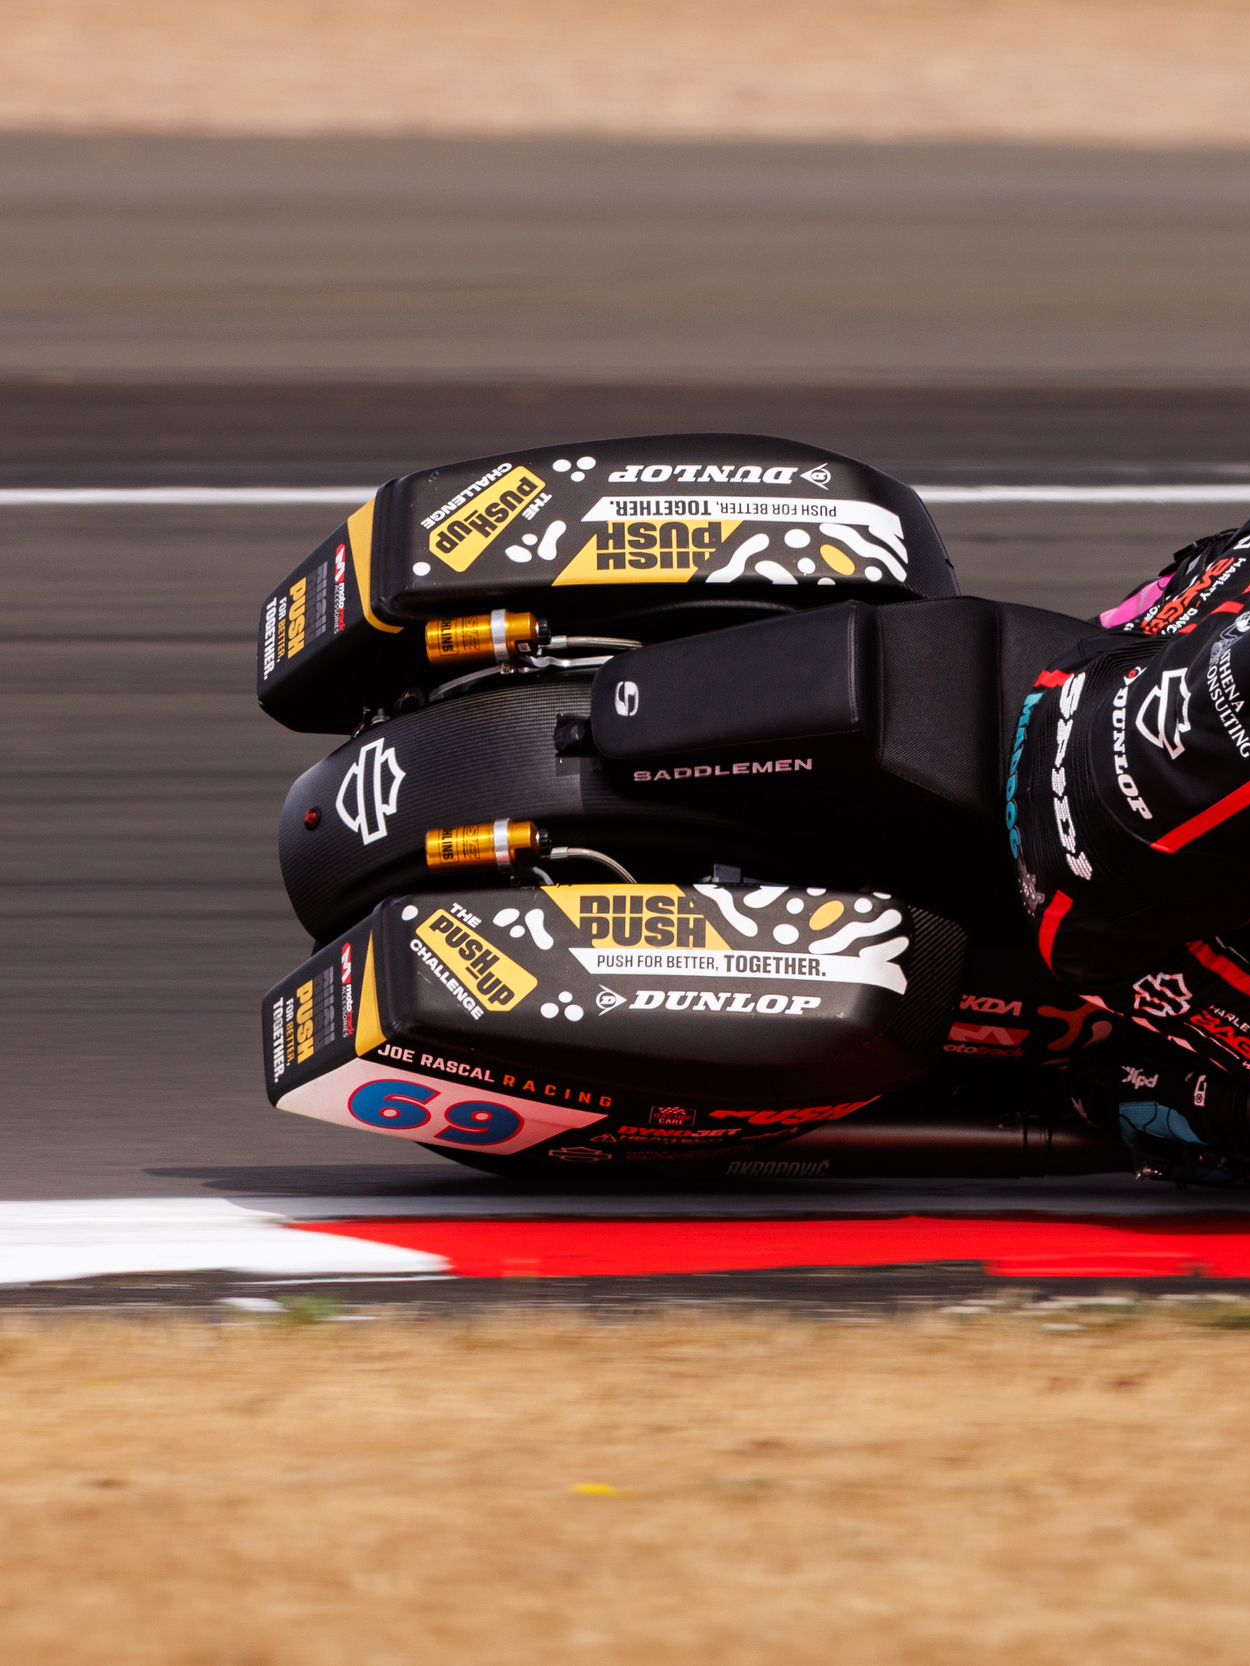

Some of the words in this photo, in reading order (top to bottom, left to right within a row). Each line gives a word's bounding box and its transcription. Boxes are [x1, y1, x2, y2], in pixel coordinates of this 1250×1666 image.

[608, 464, 798, 484] DUNLOP
[420, 462, 513, 530] CHALLENGE
[522, 492, 552, 521] THE
[610, 500, 712, 516] TOGETHER.
[716, 502, 770, 518] BETTER,
[772, 503, 798, 516] FOR
[801, 504, 837, 518] PUSH
[278, 597, 287, 620] FOR
[288, 577, 306, 659] PUSH
[264, 597, 277, 680] TOGETHER.
[441, 619, 453, 652] HLINS
[1112, 686, 1153, 820] DUNLOP
[633, 758, 813, 781] SADDLEMEN
[442, 828, 453, 860] HLINS
[450, 903, 482, 928] THE
[410, 939, 484, 1020] CHALLENGE
[597, 954, 633, 968] PUSH
[637, 955, 662, 968] FOR
[667, 956, 719, 972] BETTER,
[724, 954, 826, 977] TOGETHER.
[286, 998, 294, 1021] FOR
[629, 990, 821, 1015] DUNLOP
[296, 979, 314, 1064] PUSH
[273, 997, 285, 1083] TOGETHER.
[378, 1044, 415, 1063] JOE
[421, 1054, 495, 1083] RASCAL
[503, 1074, 612, 1107] RACING
[347, 1079, 525, 1146] 69
